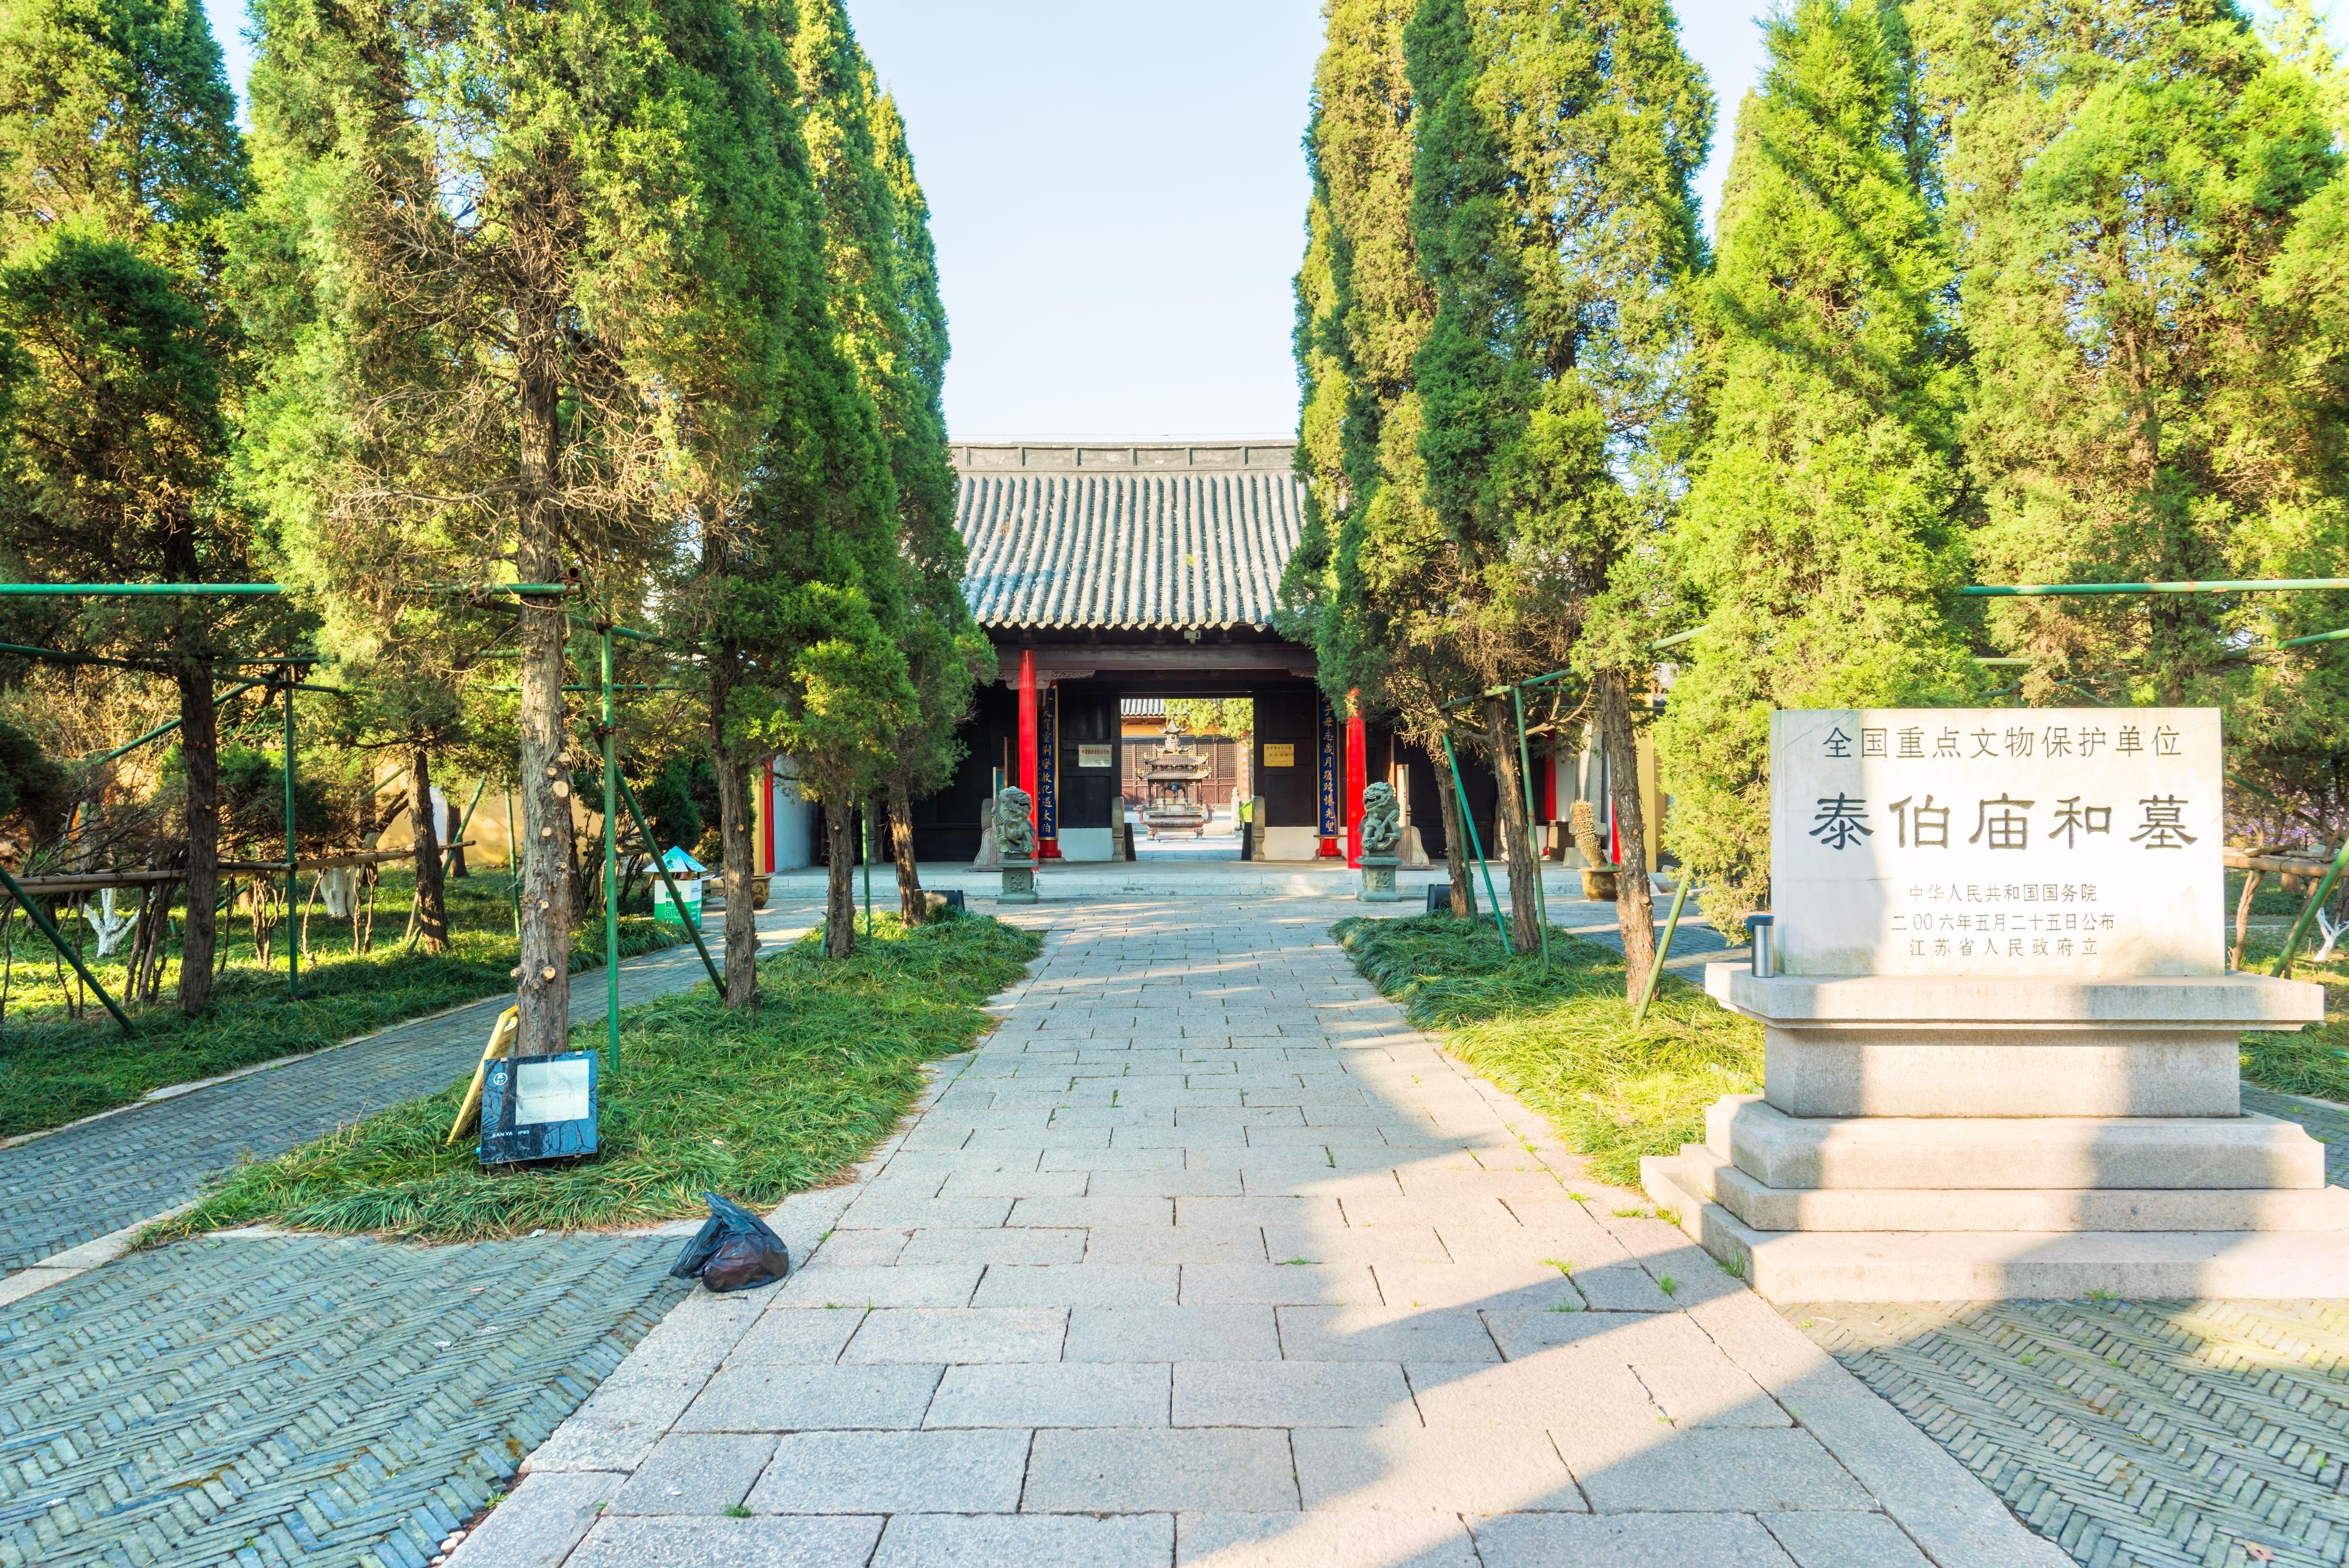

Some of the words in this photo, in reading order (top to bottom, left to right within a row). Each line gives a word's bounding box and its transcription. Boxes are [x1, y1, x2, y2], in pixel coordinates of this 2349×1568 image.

[1823, 725, 2182, 759] 全国重点文物保护单位
[1809, 792, 2199, 851] 泰伯庙和墓
[1909, 884, 2098, 903] 中华人民共和国国务院
[1909, 938, 2098, 957] 江苏省人民政府立
